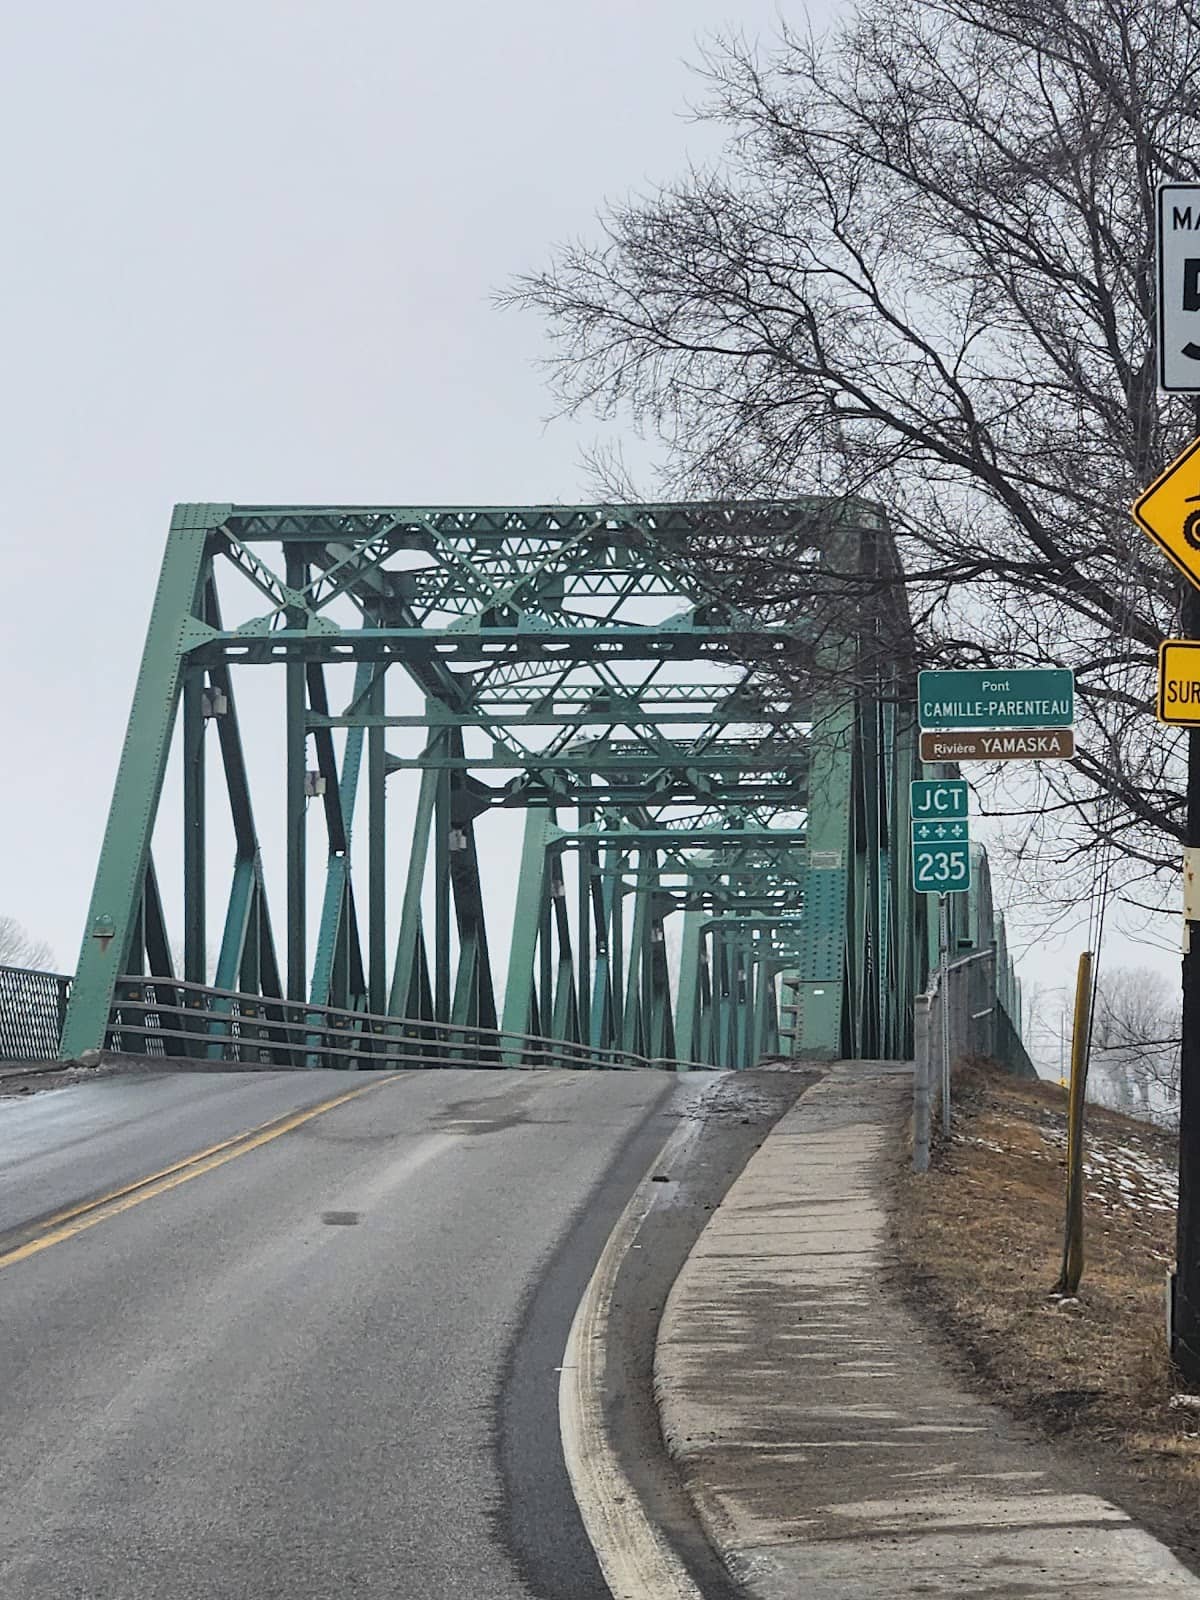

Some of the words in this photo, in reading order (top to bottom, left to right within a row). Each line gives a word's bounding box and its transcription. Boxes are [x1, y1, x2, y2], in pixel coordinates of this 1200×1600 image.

[982, 681, 1010, 692] Pont
[924, 700, 1069, 717] CAMILLE-PARENTEAU
[934, 743, 976, 754] Rivière
[981, 737, 1061, 753] YAMASKA
[918, 789, 963, 811] JCT
[918, 853, 966, 881] 235
